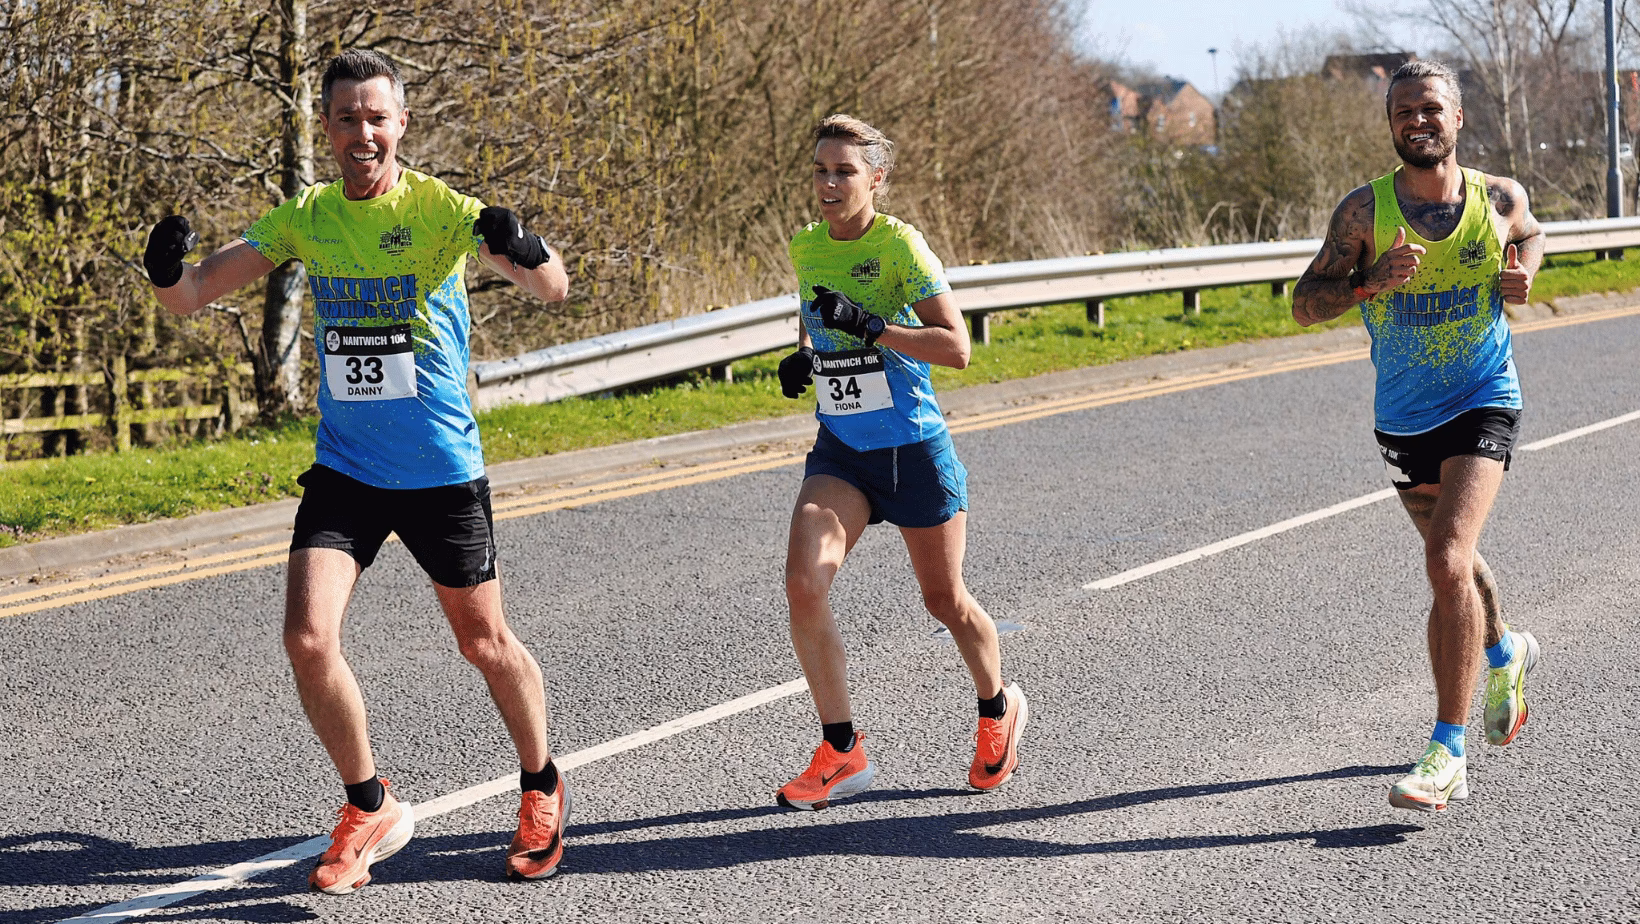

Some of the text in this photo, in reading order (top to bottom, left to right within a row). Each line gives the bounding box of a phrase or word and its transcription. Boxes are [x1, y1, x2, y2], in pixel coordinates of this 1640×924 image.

[342, 335, 387, 346] NANTWICH
[389, 333, 407, 344] 10K
[822, 357, 861, 369] NANTWICH
[863, 355, 879, 365] 10K
[345, 356, 384, 384] 33
[348, 386, 383, 396] DANNY
[828, 377, 862, 401] 34
[835, 401, 862, 411] FIONA
[1388, 449, 1399, 461] 10K
